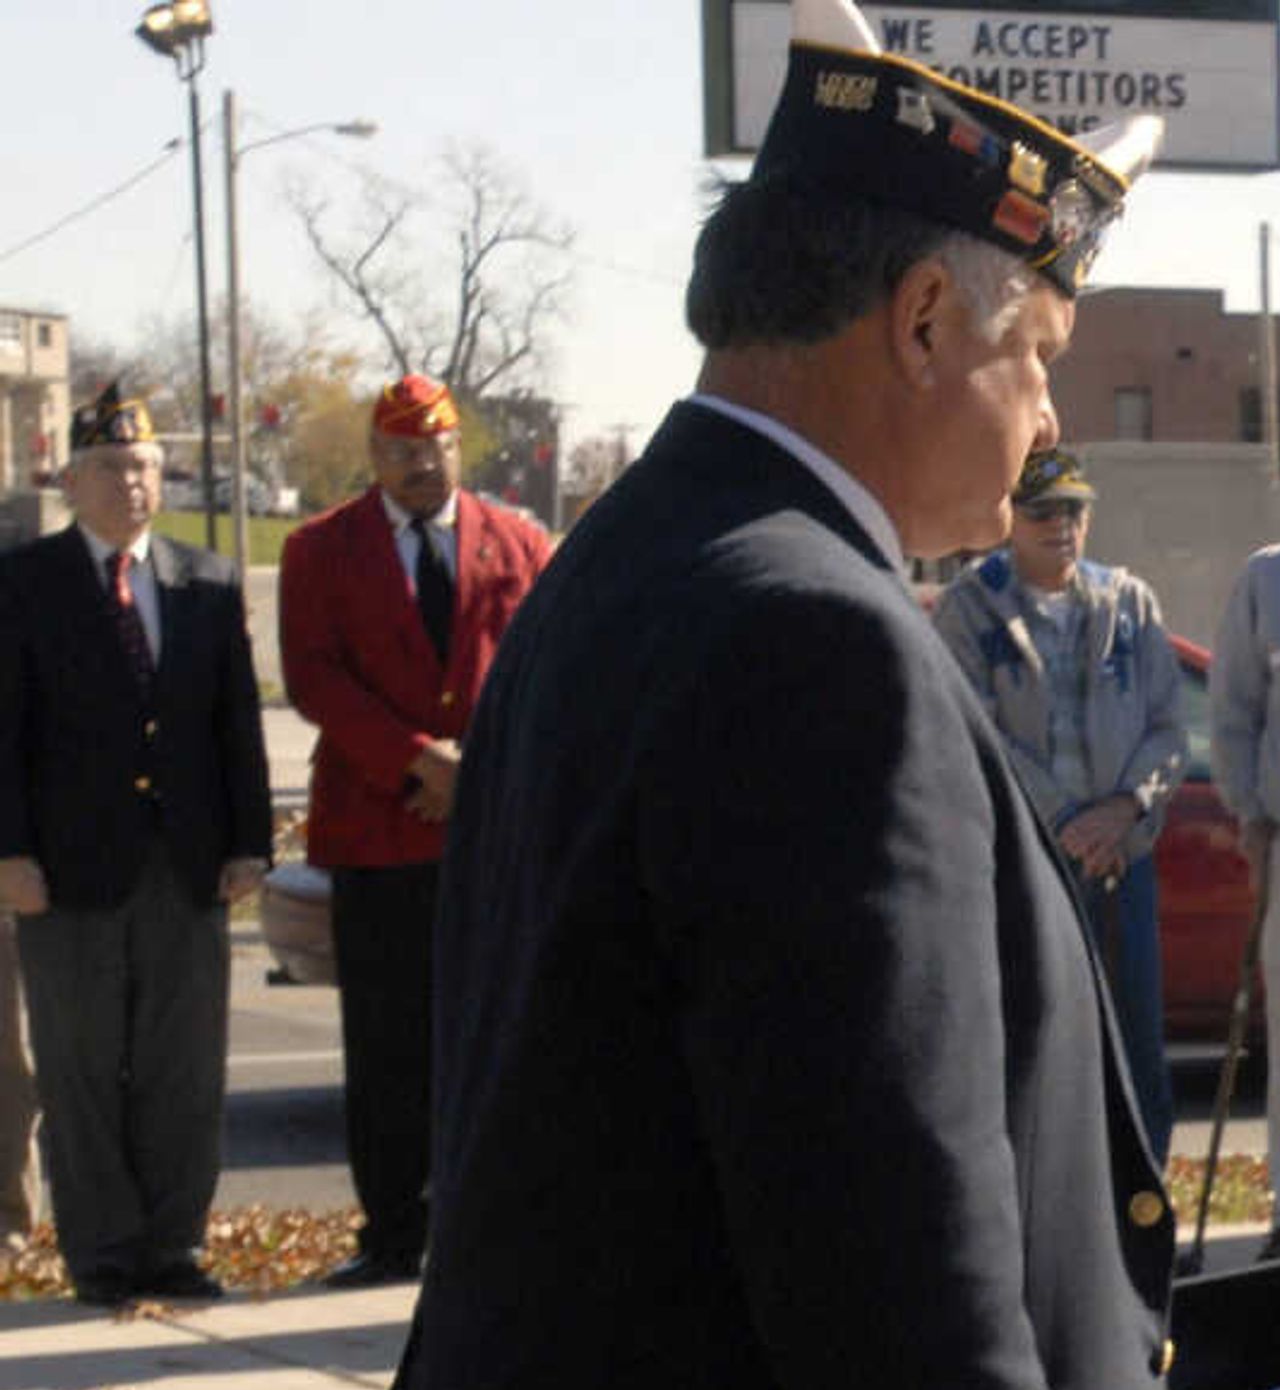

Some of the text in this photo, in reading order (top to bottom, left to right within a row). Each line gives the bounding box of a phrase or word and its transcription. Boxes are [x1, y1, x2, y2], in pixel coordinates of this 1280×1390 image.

[881, 18, 1112, 59] WE ACCEPT
[931, 65, 1187, 108] OMPETITORS
